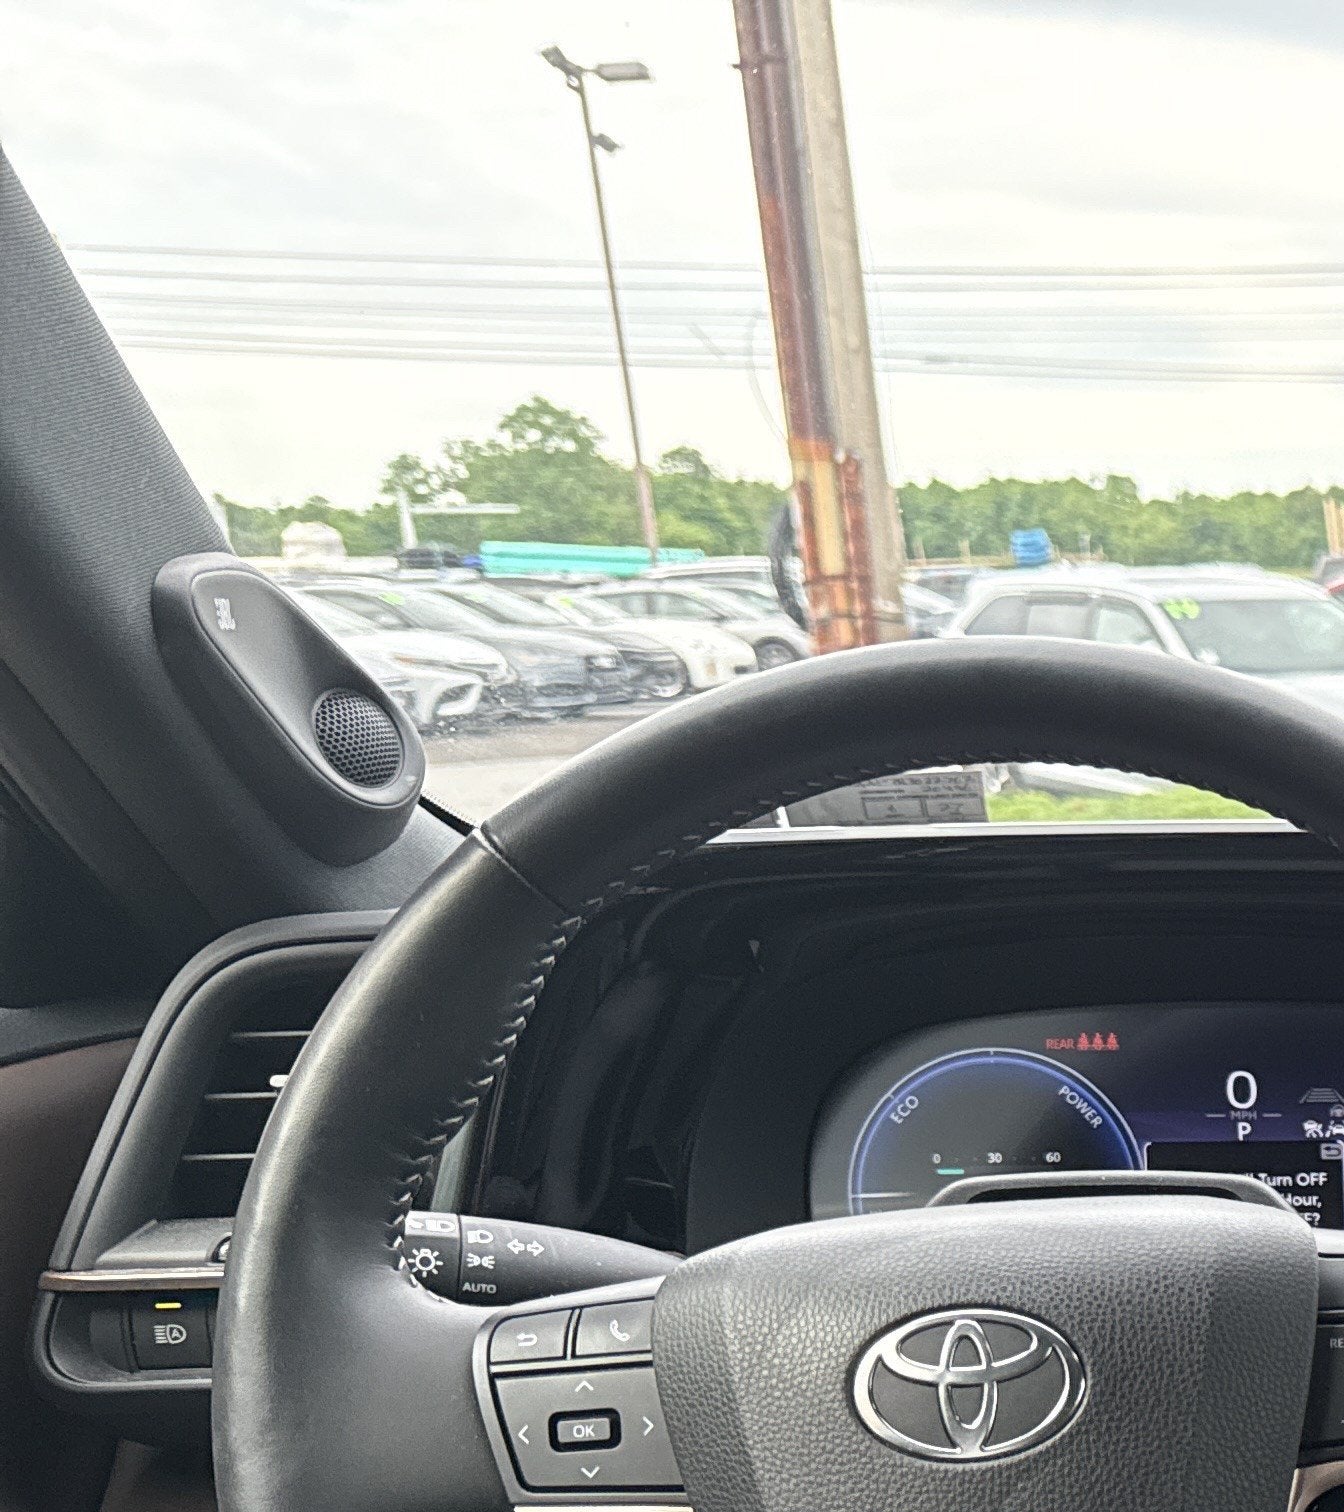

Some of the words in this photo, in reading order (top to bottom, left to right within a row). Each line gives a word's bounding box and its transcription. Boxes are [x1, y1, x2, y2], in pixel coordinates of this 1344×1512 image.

[1046, 1038, 1075, 1050] REAR
[1226, 1070, 1258, 1109] 0
[889, 1095, 919, 1125] ECO
[1058, 1085, 1102, 1129] POWER
[1229, 1111, 1258, 1121] MPH
[1237, 1122, 1252, 1141] P
[932, 1153, 941, 1164] 0
[987, 1152, 1002, 1164] 30
[1046, 1152, 1061, 1163] 60
[1258, 1173, 1293, 1187] Turn
[1296, 1172, 1328, 1186] OFF
[462, 1282, 497, 1294] AUTO
[573, 1425, 596, 1438] OK
